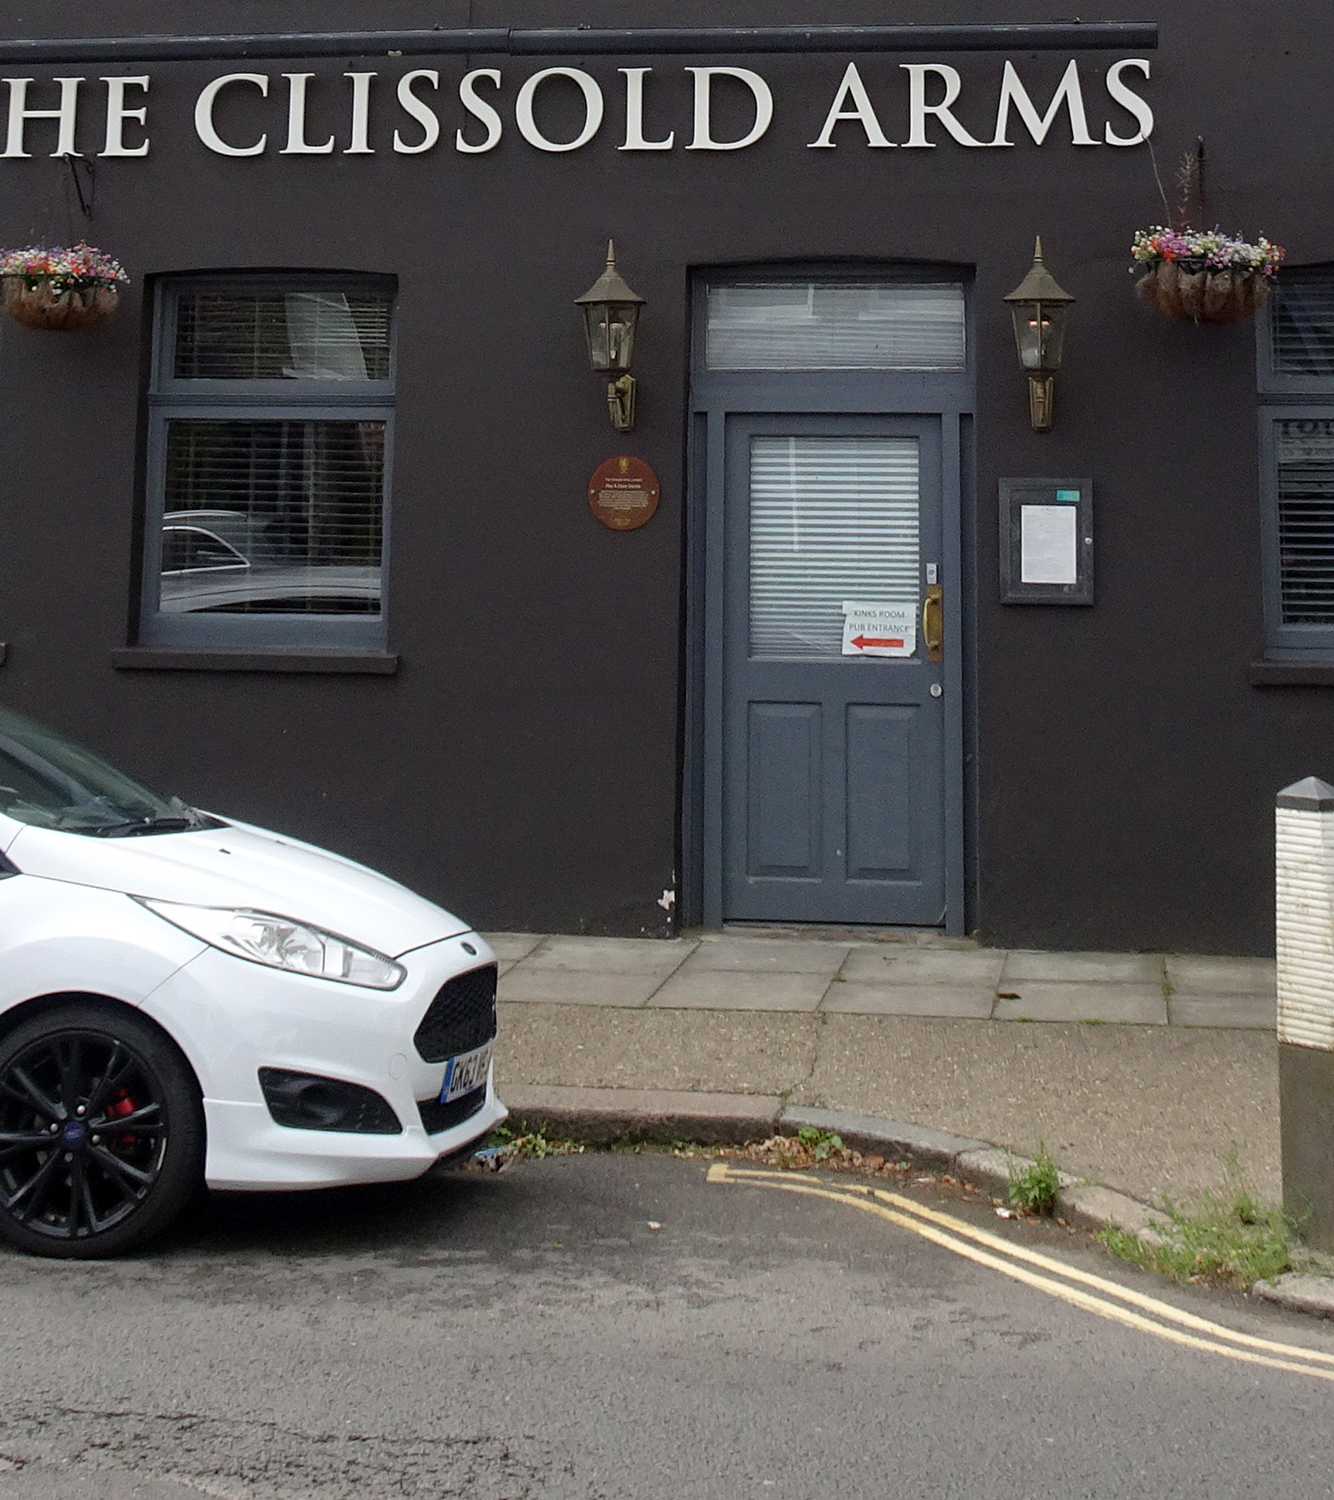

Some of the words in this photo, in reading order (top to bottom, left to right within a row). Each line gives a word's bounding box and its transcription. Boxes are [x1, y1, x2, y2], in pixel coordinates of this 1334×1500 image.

[193, 66, 774, 158] CLISSOLD
[806, 57, 1156, 149] ARMS
[854, 610, 877, 618] KINKS
[879, 610, 905, 618] ROOM
[849, 623, 865, 631] PUB
[867, 624, 909, 633] ENTRANCE
